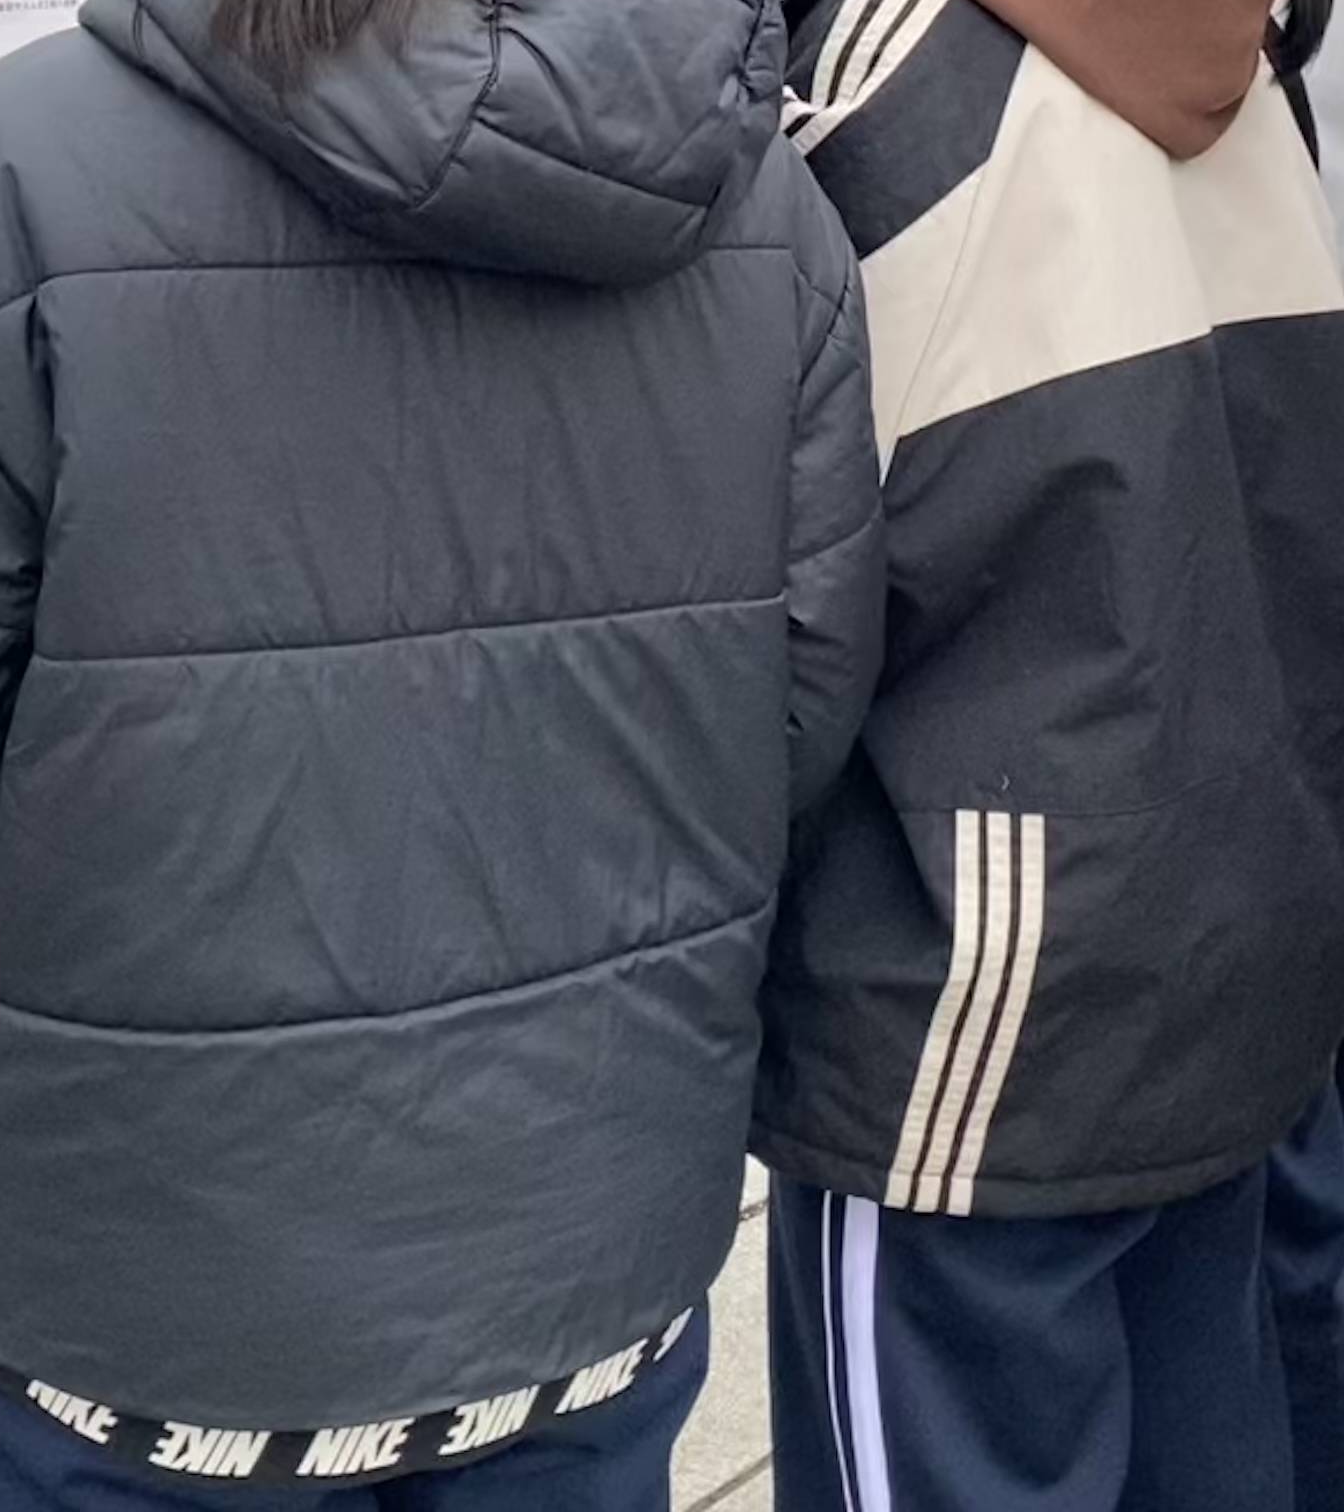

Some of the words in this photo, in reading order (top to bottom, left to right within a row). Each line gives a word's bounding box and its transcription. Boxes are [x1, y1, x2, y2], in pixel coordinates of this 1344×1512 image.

[147, 1420, 272, 1478] NIKE
[294, 1417, 416, 1477] NIKE
[437, 1384, 541, 1456] NIKE
[554, 1337, 649, 1415] NIKE
